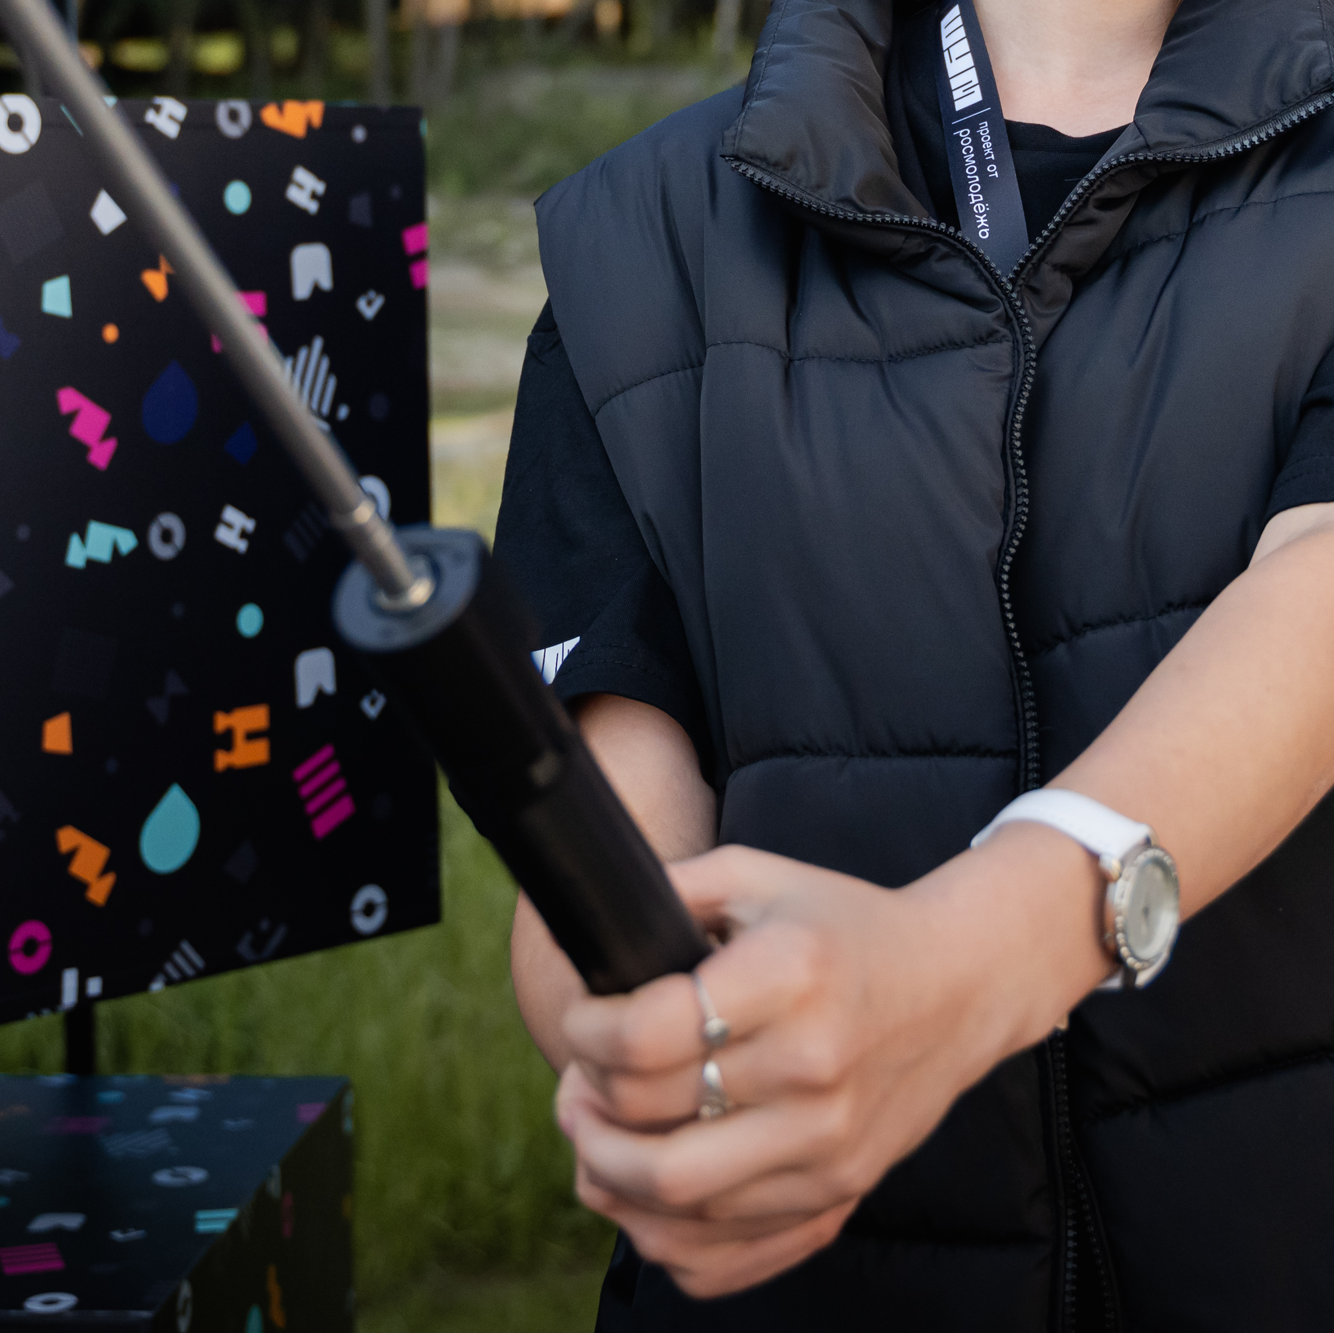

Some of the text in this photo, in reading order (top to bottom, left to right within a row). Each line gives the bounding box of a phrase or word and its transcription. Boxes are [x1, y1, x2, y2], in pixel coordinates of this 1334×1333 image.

[940, 3, 983, 112] ШУМ
[953, 128, 989, 239] росмолодёжь
[978, 121, 998, 178] проект от
